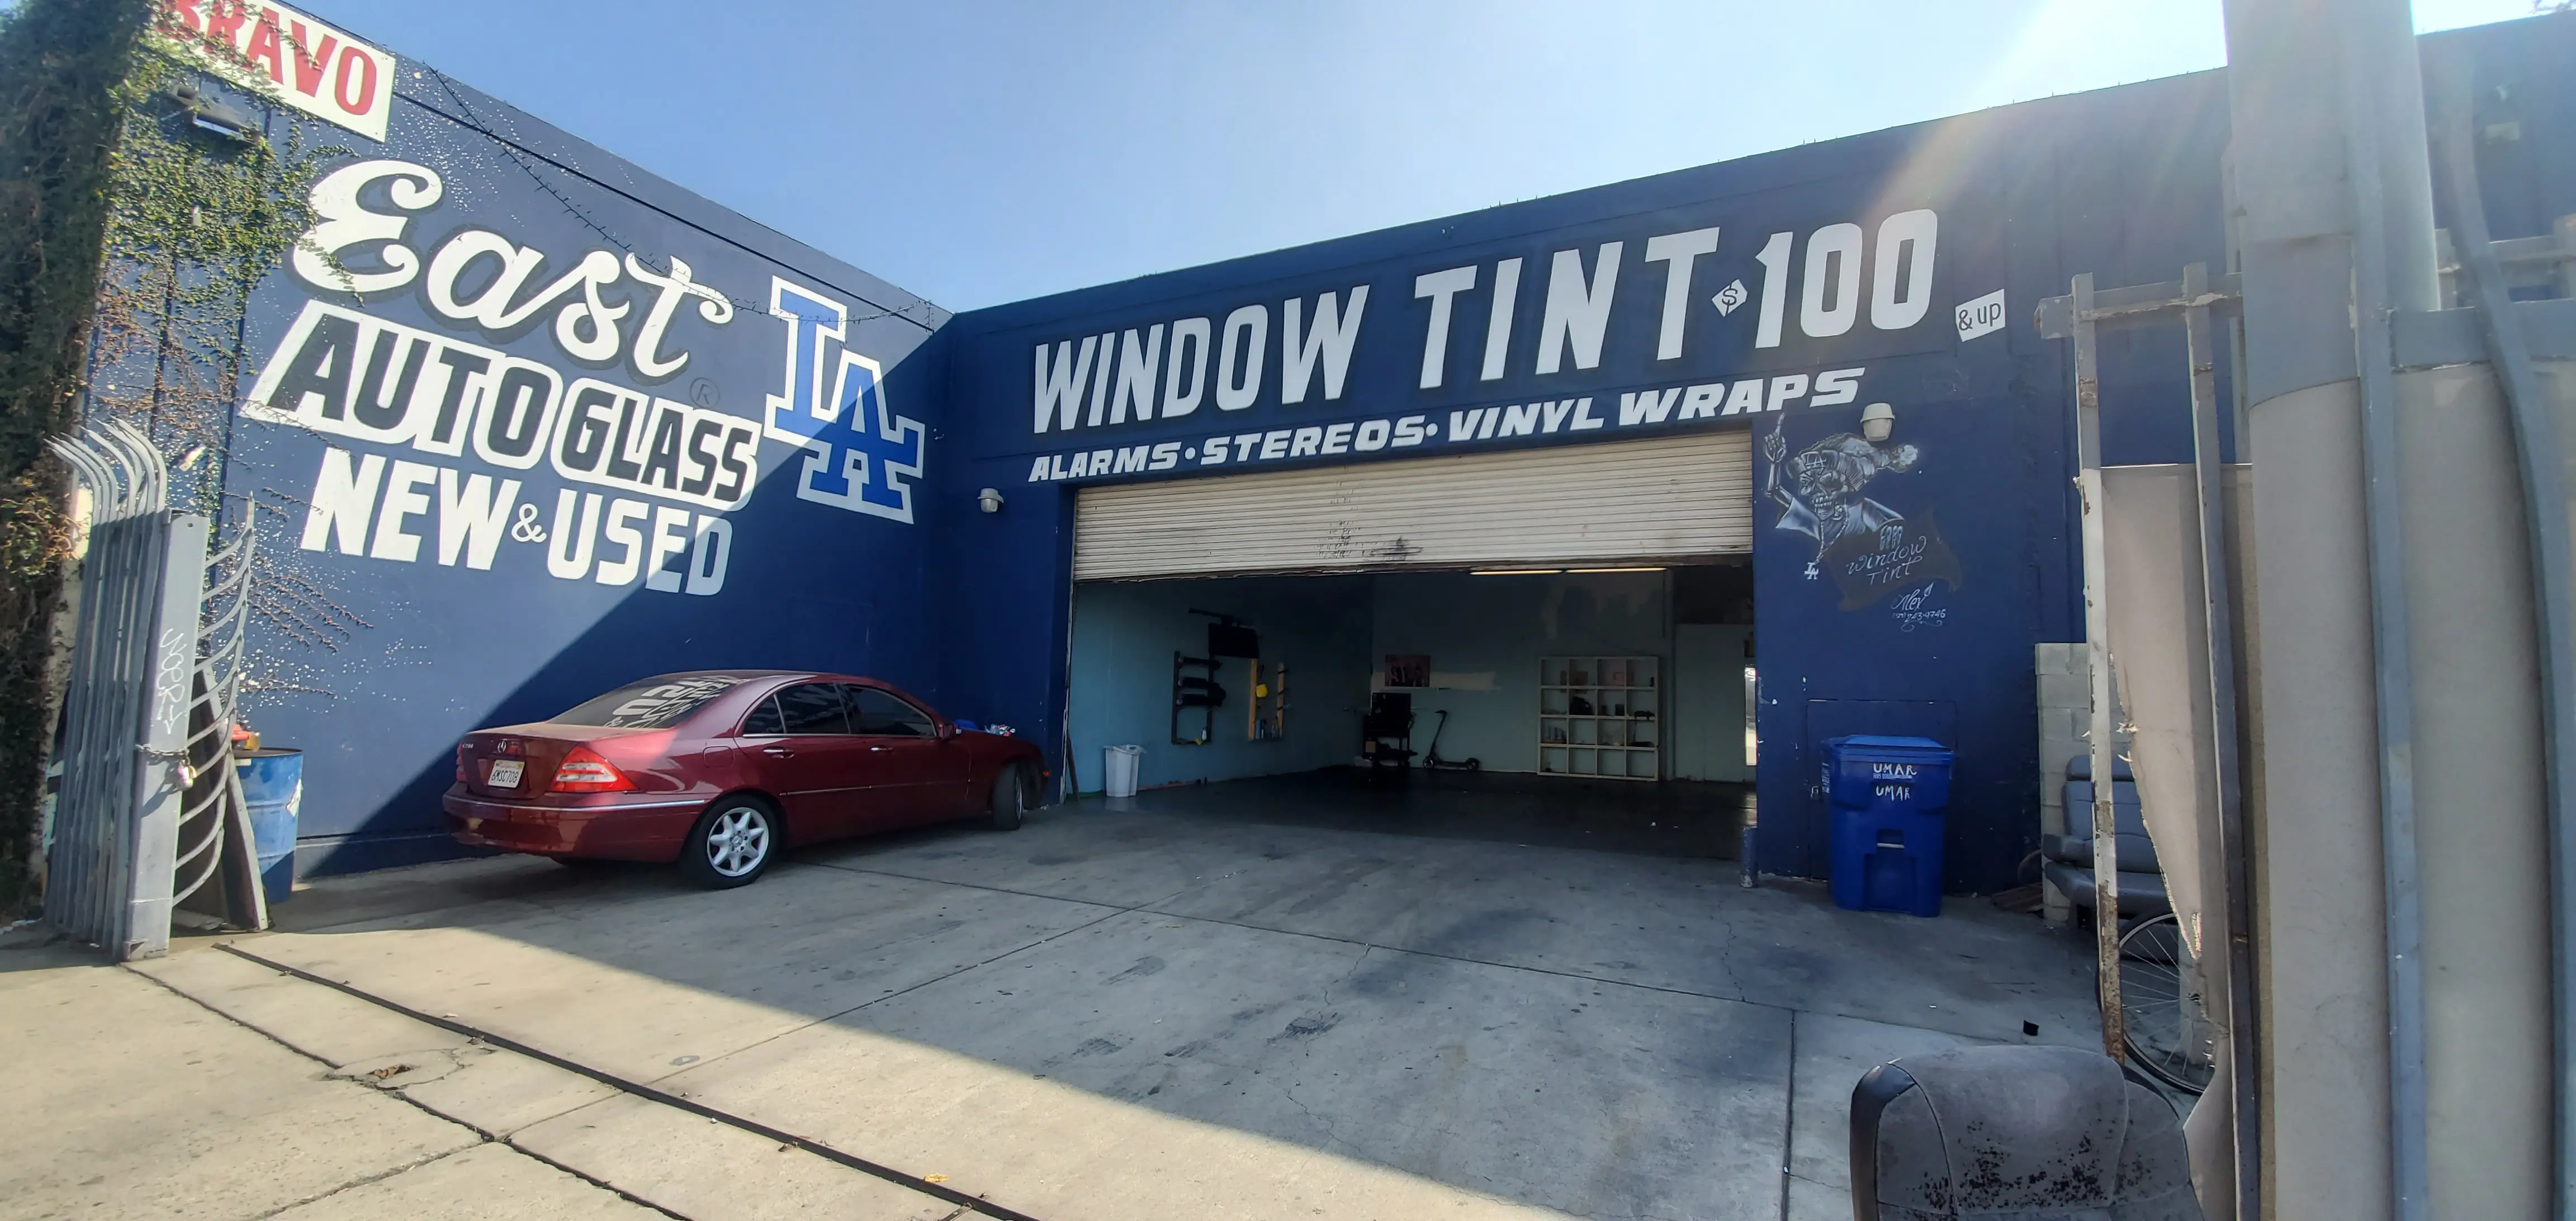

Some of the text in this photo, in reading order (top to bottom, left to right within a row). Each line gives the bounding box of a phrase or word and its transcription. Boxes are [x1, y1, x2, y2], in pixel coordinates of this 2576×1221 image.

[292, 159, 735, 377] East
[1033, 226, 1721, 434] WINDOW TINT
[1755, 209, 1938, 349] 100
[1958, 309, 1973, 332] &
[1977, 302, 2001, 326] up
[265, 310, 753, 504] AUTO GLASS
[763, 275, 926, 525] LA
[1027, 367, 1866, 482] ALARMS STEREOS VINYL WRAPS
[300, 447, 734, 597] NEW & USED
[1866, 556, 1923, 585] Tint
[1873, 763, 1917, 776] UMAR
[1876, 785, 1911, 802] UMAR
